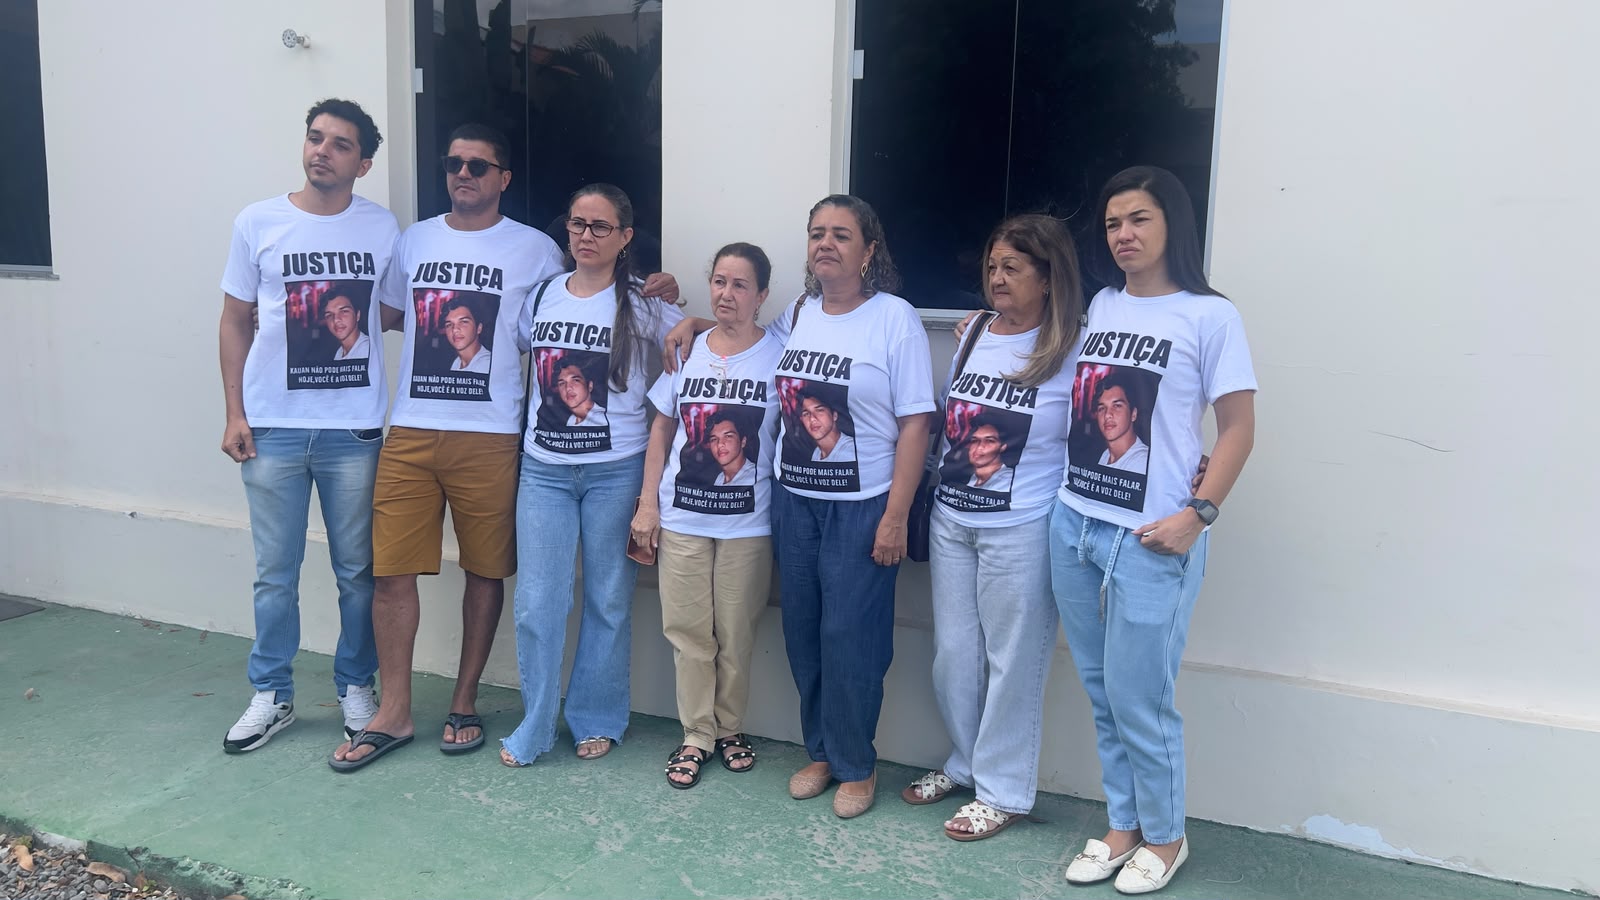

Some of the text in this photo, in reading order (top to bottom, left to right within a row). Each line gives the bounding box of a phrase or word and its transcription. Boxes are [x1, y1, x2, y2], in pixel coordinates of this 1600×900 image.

[282, 252, 376, 279] JUSTIÇA
[412, 262, 503, 291] JUSTIÇA
[532, 321, 611, 350] JUSTIÇA
[1079, 331, 1173, 369] JUSTIÇA
[311, 365, 323, 374] NÃO
[777, 349, 853, 381] JUSTIÇA
[428, 374, 439, 383] NÃO
[440, 376, 455, 384] PODE
[456, 377, 472, 385] MAIS
[456, 387, 467, 395] VOZ
[680, 377, 768, 404] JUSTIÇA
[952, 372, 1040, 409] JUSTIÇA
[588, 431, 608, 439] FALAR.
[573, 441, 584, 449] VOZ
[792, 464, 802, 473] NÃO
[802, 467, 816, 475] PODE
[817, 468, 834, 476] MAIS
[834, 468, 855, 476] FALAR.
[819, 478, 830, 486] VOZ
[831, 478, 848, 486] DELE!
[1087, 470, 1101, 481] PODE
[1101, 474, 1118, 486] MAIS
[1118, 478, 1142, 491] FALAR.
[692, 487, 702, 497] NÃO
[704, 491, 718, 499] PODE
[1090, 481, 1095, 492] É
[1095, 485, 1100, 494] A
[1101, 486, 1112, 496] VOZ
[1113, 489, 1132, 501] DELE!
[718, 501, 729, 509] VOZ
[730, 501, 745, 509] DELE!
